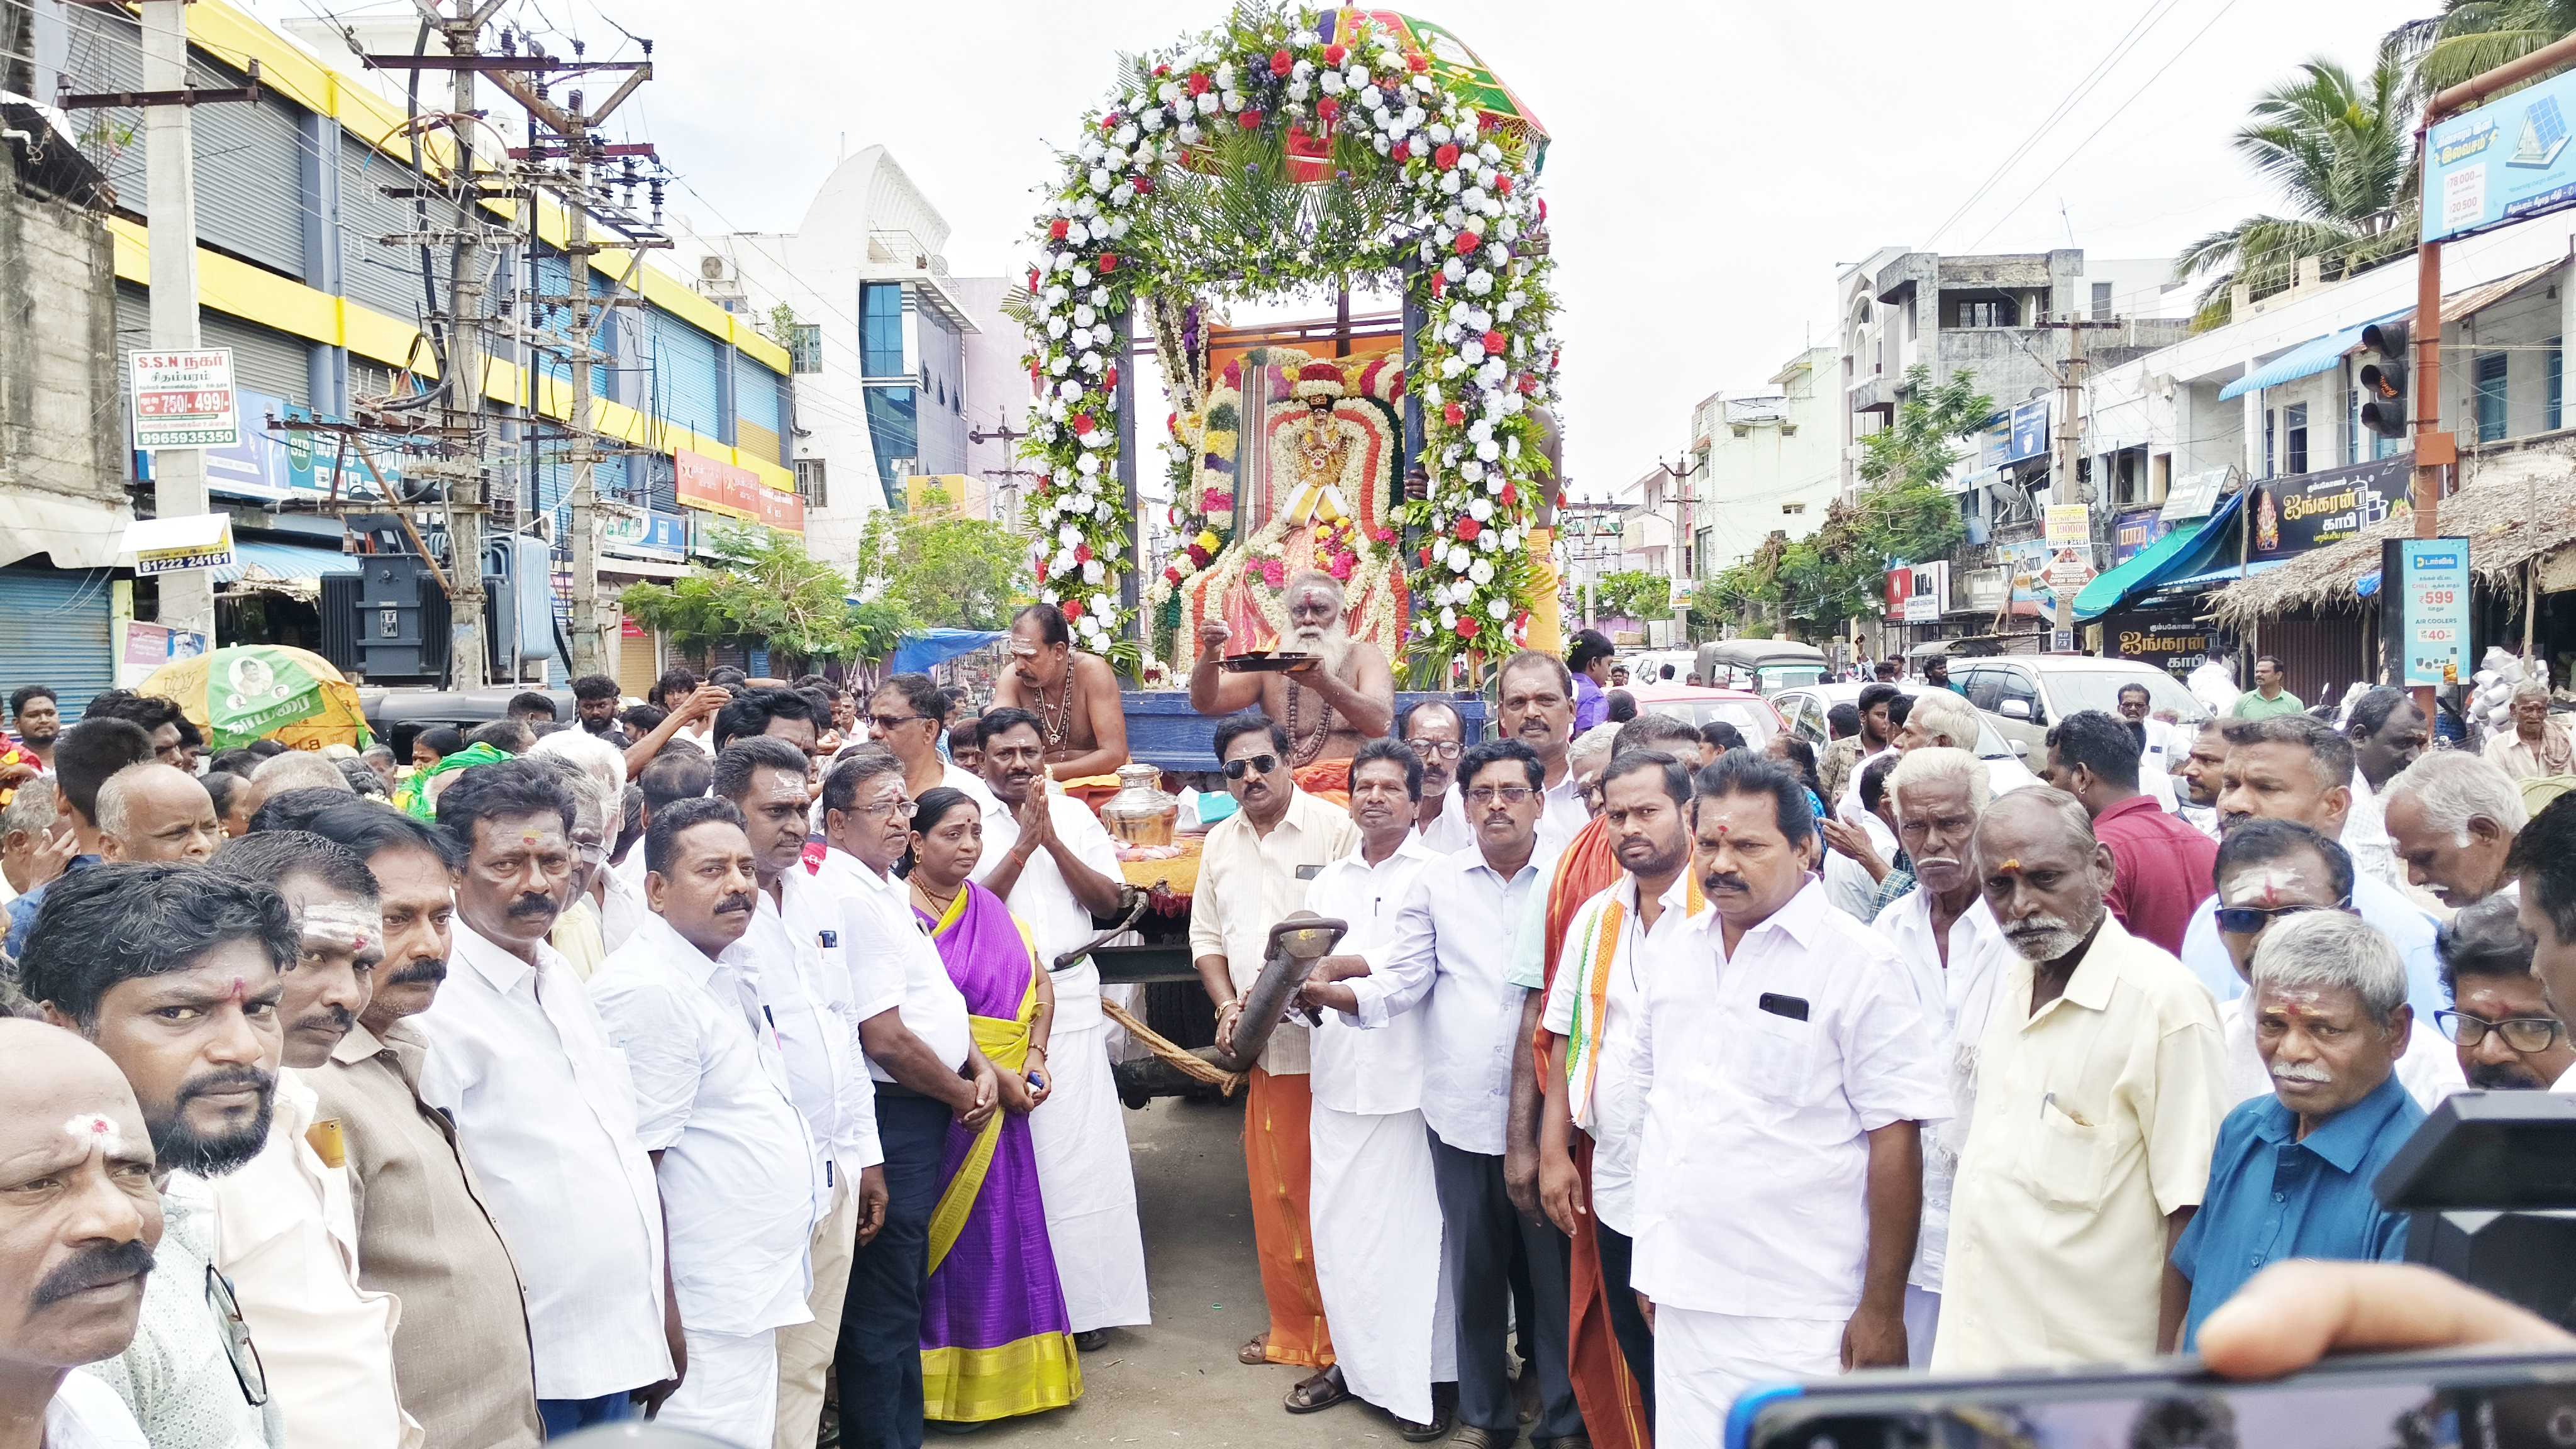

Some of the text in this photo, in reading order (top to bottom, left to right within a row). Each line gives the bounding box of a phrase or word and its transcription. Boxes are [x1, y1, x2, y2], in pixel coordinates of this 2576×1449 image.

[138, 352, 223, 370] S.S.N நகர்
[151, 370, 211, 383] சிதம்பரம்
[195, 392, 229, 411] 499/-
[142, 431, 233, 444] 9965935350
[2284, 487, 2357, 521] ஐங்கரன்
[2323, 512, 2357, 531] காபி
[142, 553, 229, 572] 81222 24161
[2119, 631, 2207, 655] ஐங்கரன்
[2428, 630, 2445, 640] 40
[2167, 653, 2206, 668] காபி
[225, 694, 311, 739] தாமரை
